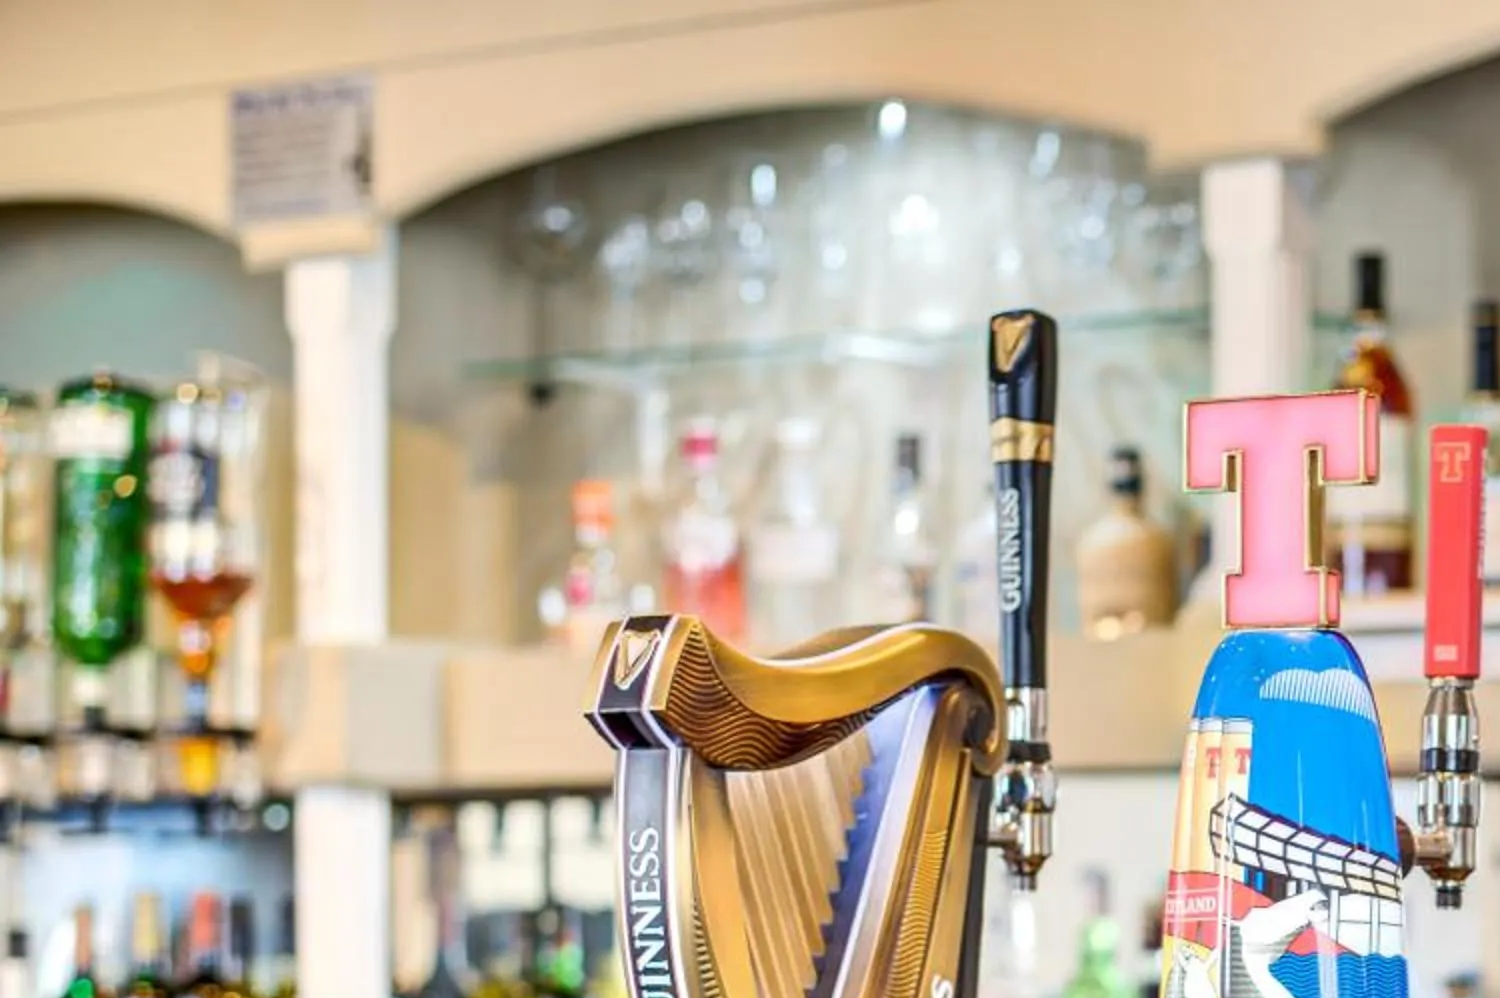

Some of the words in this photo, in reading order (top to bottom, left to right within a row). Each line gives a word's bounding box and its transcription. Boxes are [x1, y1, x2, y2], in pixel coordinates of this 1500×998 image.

[1182, 387, 1380, 631] T
[1434, 442, 1471, 482] T
[1002, 488, 1021, 613] GUINNESS
